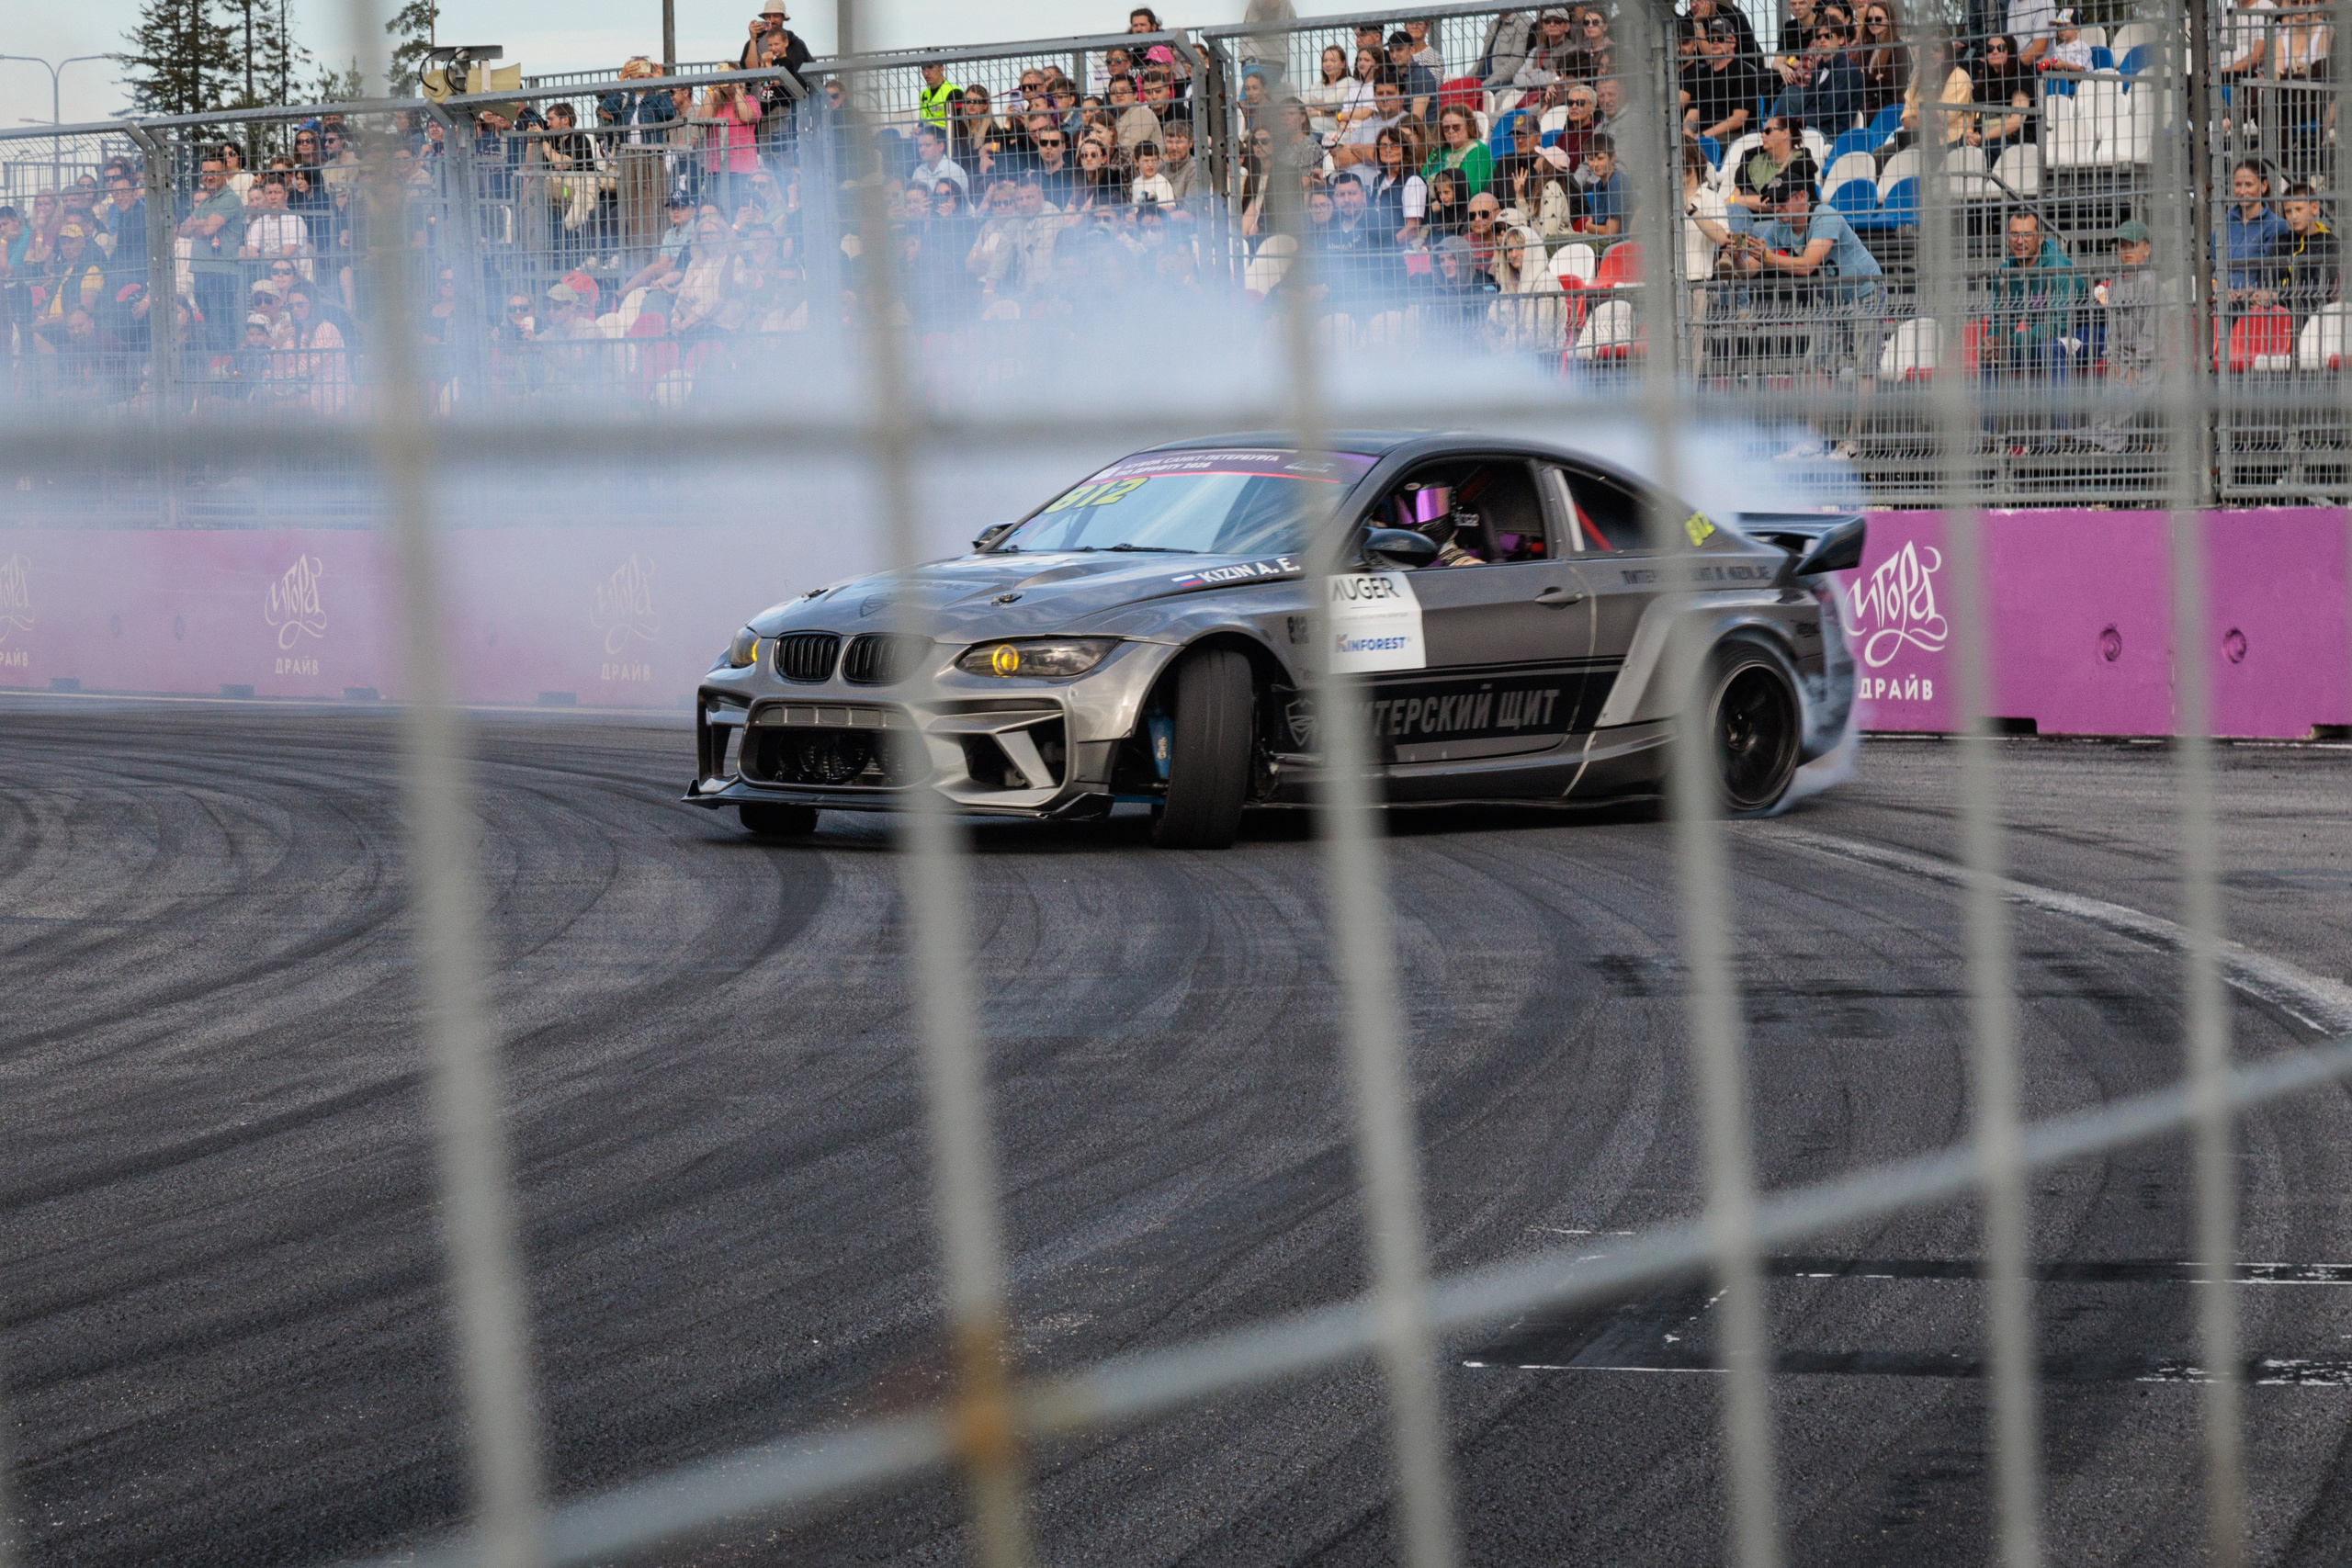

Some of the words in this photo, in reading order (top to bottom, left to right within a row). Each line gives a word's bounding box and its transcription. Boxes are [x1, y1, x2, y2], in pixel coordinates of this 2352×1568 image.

[1197, 564, 1257, 582] KIZIN
[1332, 577, 1401, 602] AUGER
[275, 655, 320, 675] ДРАЙВ
[600, 660, 651, 681] ДРАЙВ
[1858, 674, 1933, 700] ДРАЙВ
[1496, 689, 1560, 730] ЩИТ
